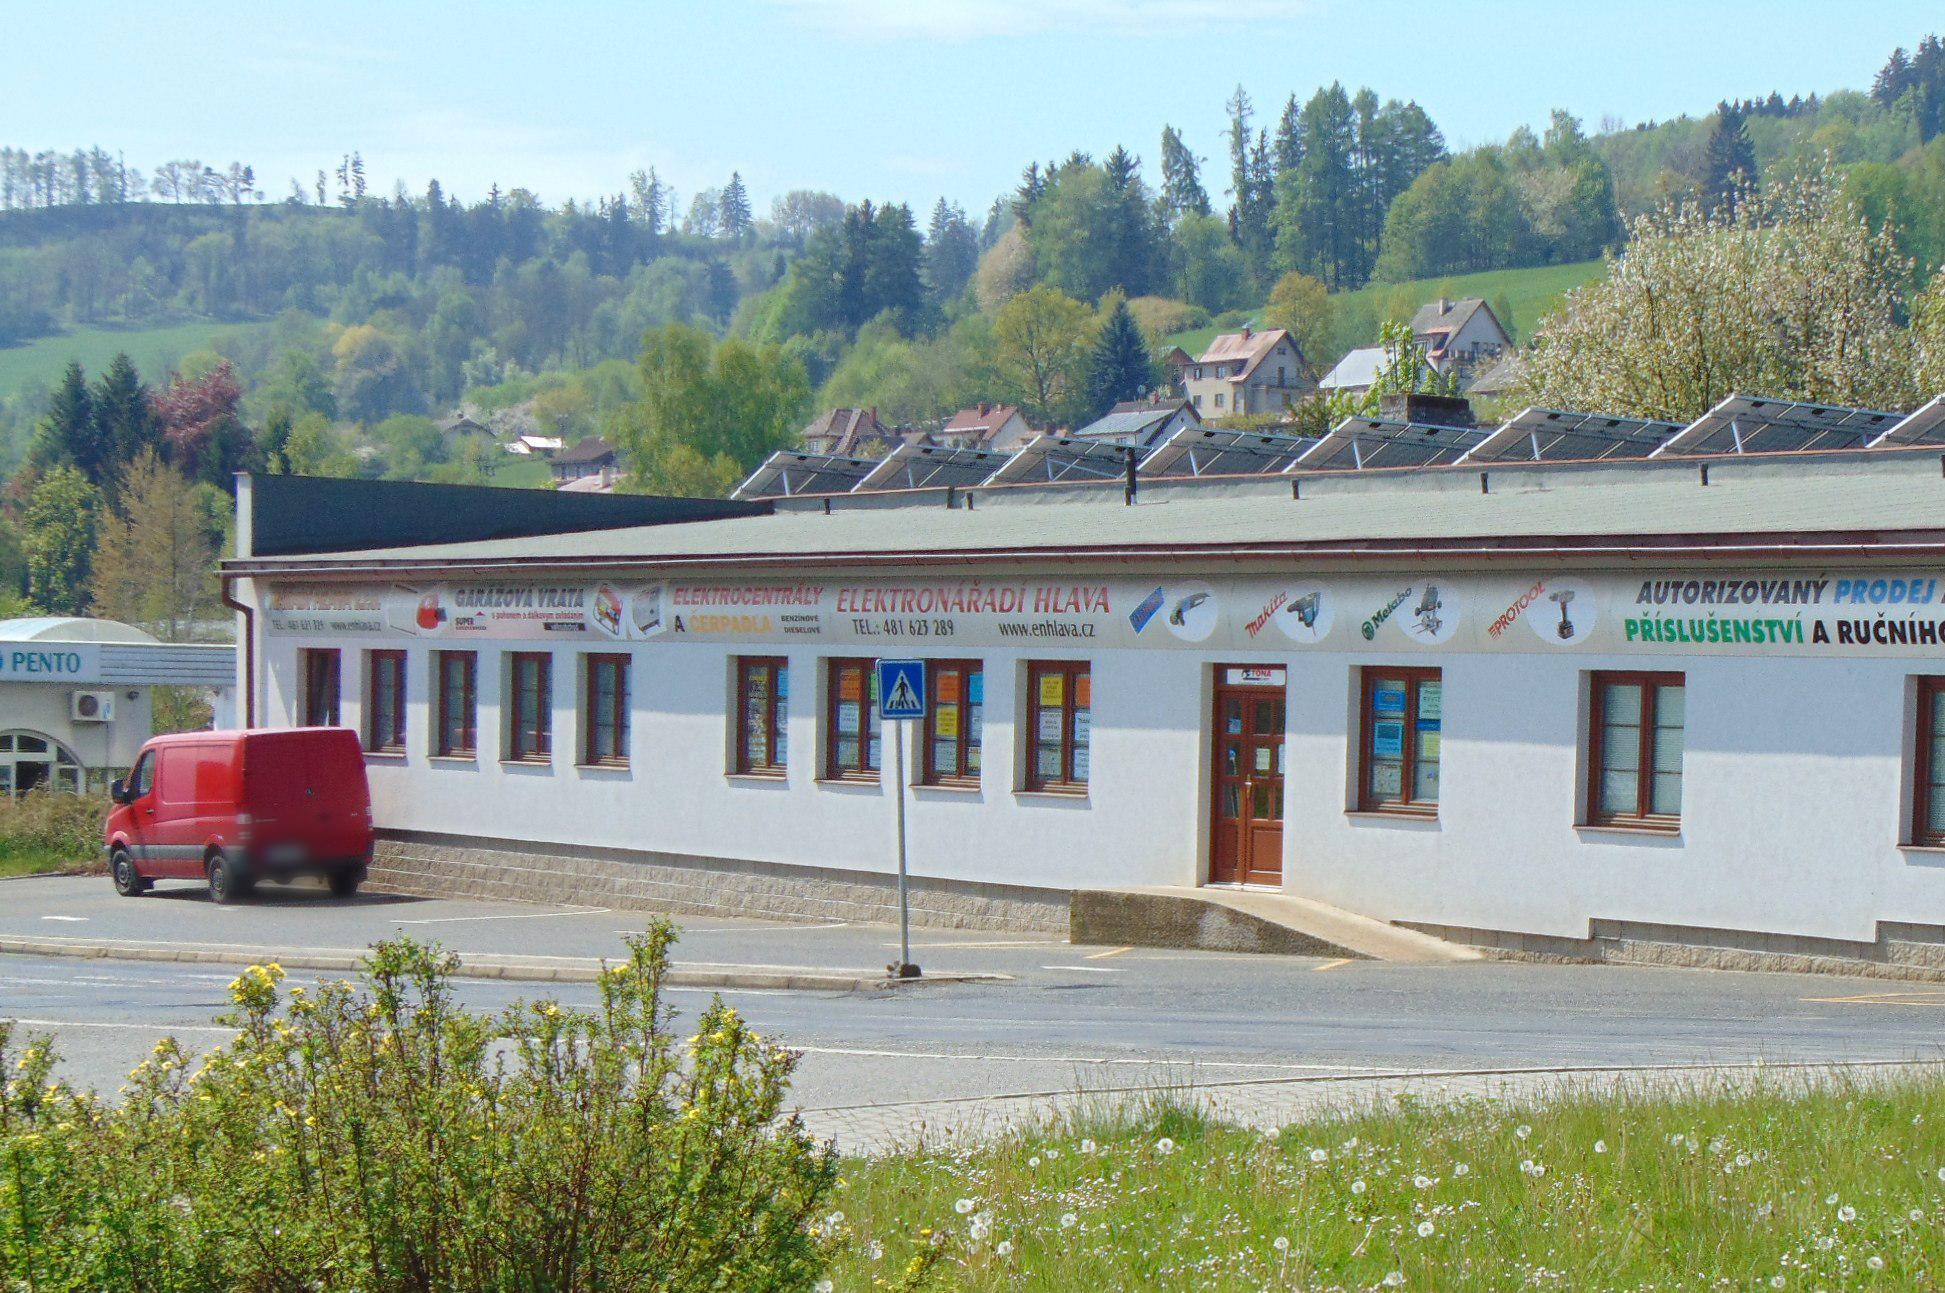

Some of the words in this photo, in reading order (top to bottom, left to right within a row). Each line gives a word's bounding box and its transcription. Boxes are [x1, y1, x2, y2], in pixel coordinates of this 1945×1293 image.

[537, 588, 584, 608] VRATA
[836, 579, 1027, 614] ELEKTRONÁŘADÍ
[1034, 586, 1111, 614] HLAVA
[1636, 574, 1829, 604] AUTORIZOVANÝ
[1833, 578, 1937, 604] PRODEJ
[1488, 577, 1549, 639] PROTOOL
[674, 615, 686, 633] A
[690, 609, 774, 634] ČERPADLA
[883, 619, 904, 636] 481
[909, 619, 929, 637] 623
[934, 619, 955, 636] 289
[998, 619, 1096, 638] www.enhlava.cz
[1625, 611, 1804, 644] PŘÍSLUŠENSTVÍ
[1812, 620, 1831, 644] A
[12, 652, 81, 673] PENTO
